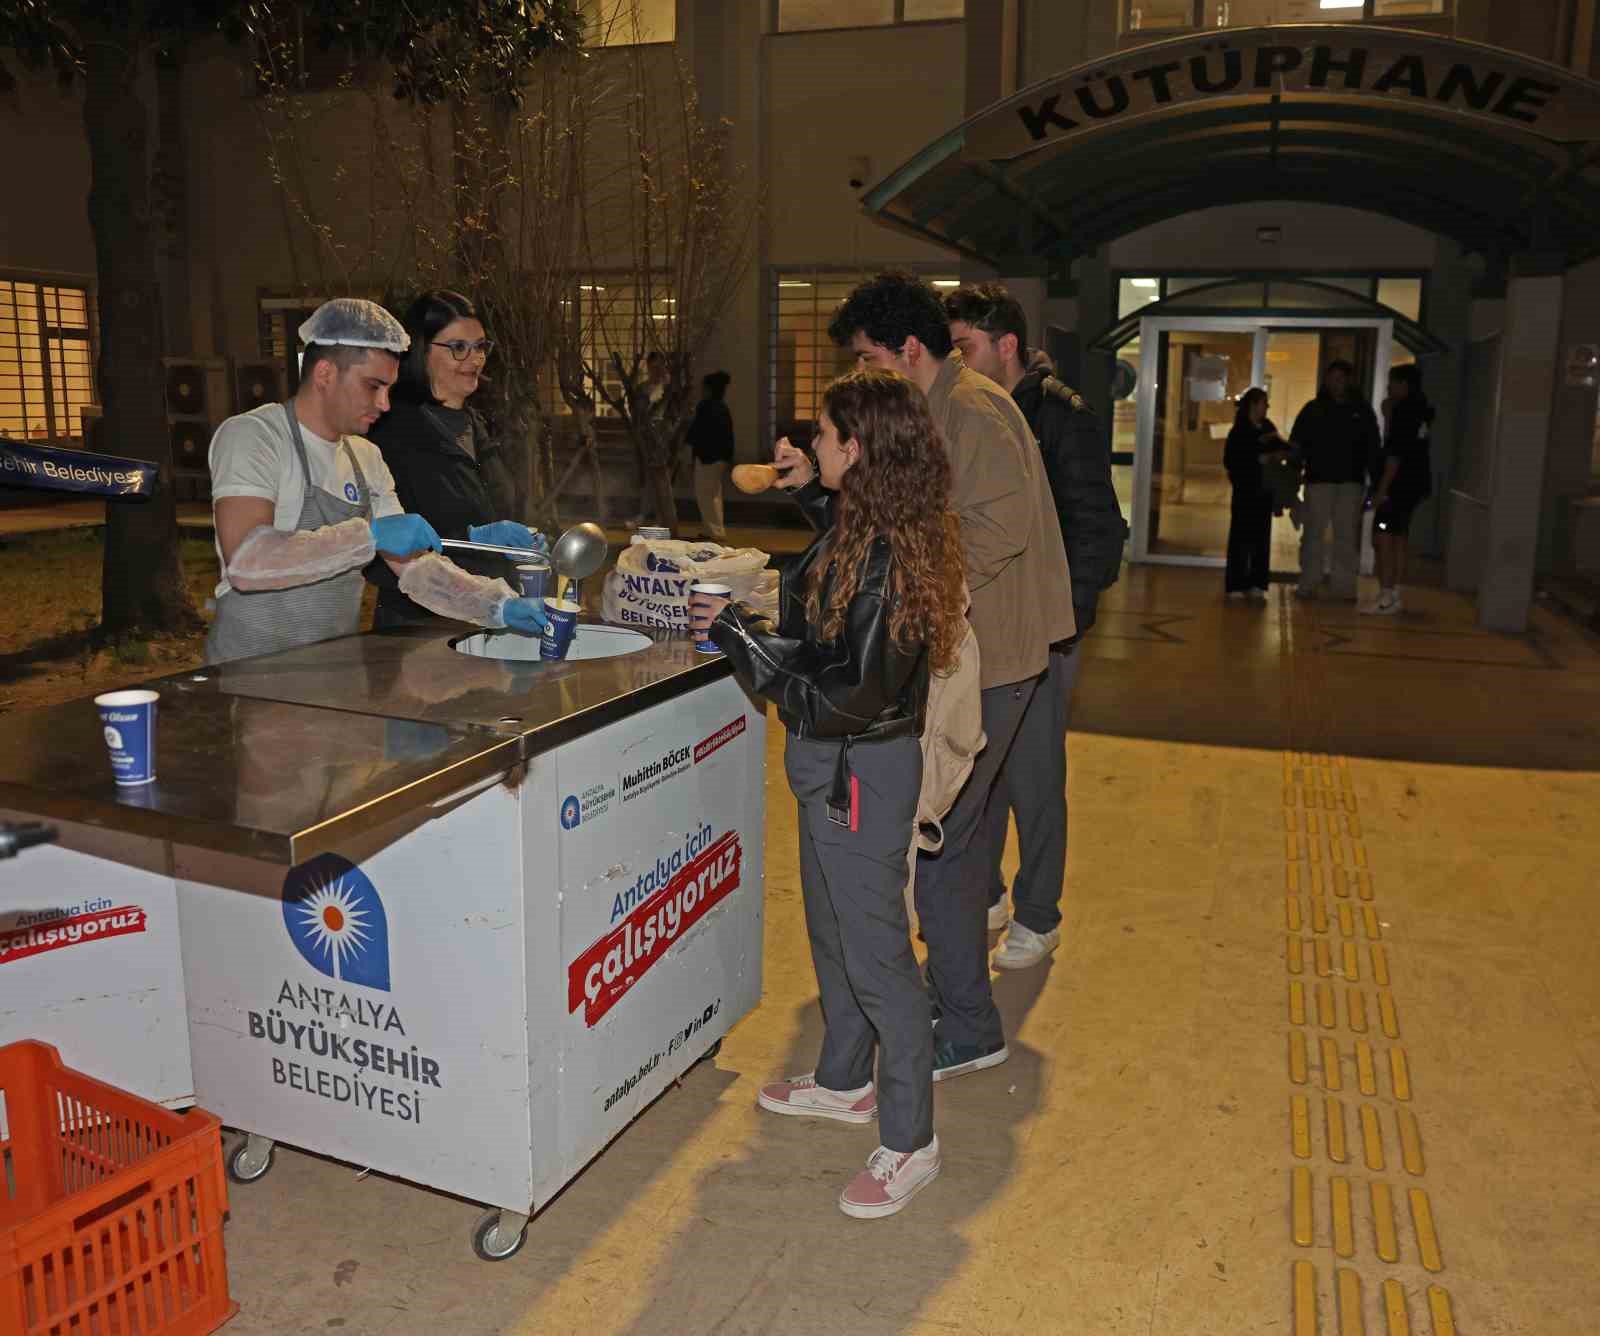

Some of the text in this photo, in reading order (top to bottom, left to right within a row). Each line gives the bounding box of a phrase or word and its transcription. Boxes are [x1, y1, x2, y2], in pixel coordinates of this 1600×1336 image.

[1016, 40, 1561, 141] KÜTÜPHANE
[622, 760, 661, 791] Muhittin
[662, 744, 691, 771] BÖCEK
[611, 822, 712, 925] Antalya için
[16, 897, 112, 927] Antalya için
[584, 842, 737, 1005] çalışıyoruz
[277, 979, 406, 1037] ANTALYA
[248, 1008, 442, 1088] BÜYÜKŞEHİR
[272, 1057, 420, 1124] BELEDİYESİ
[603, 1053, 661, 1113] antalya.bel.tr
